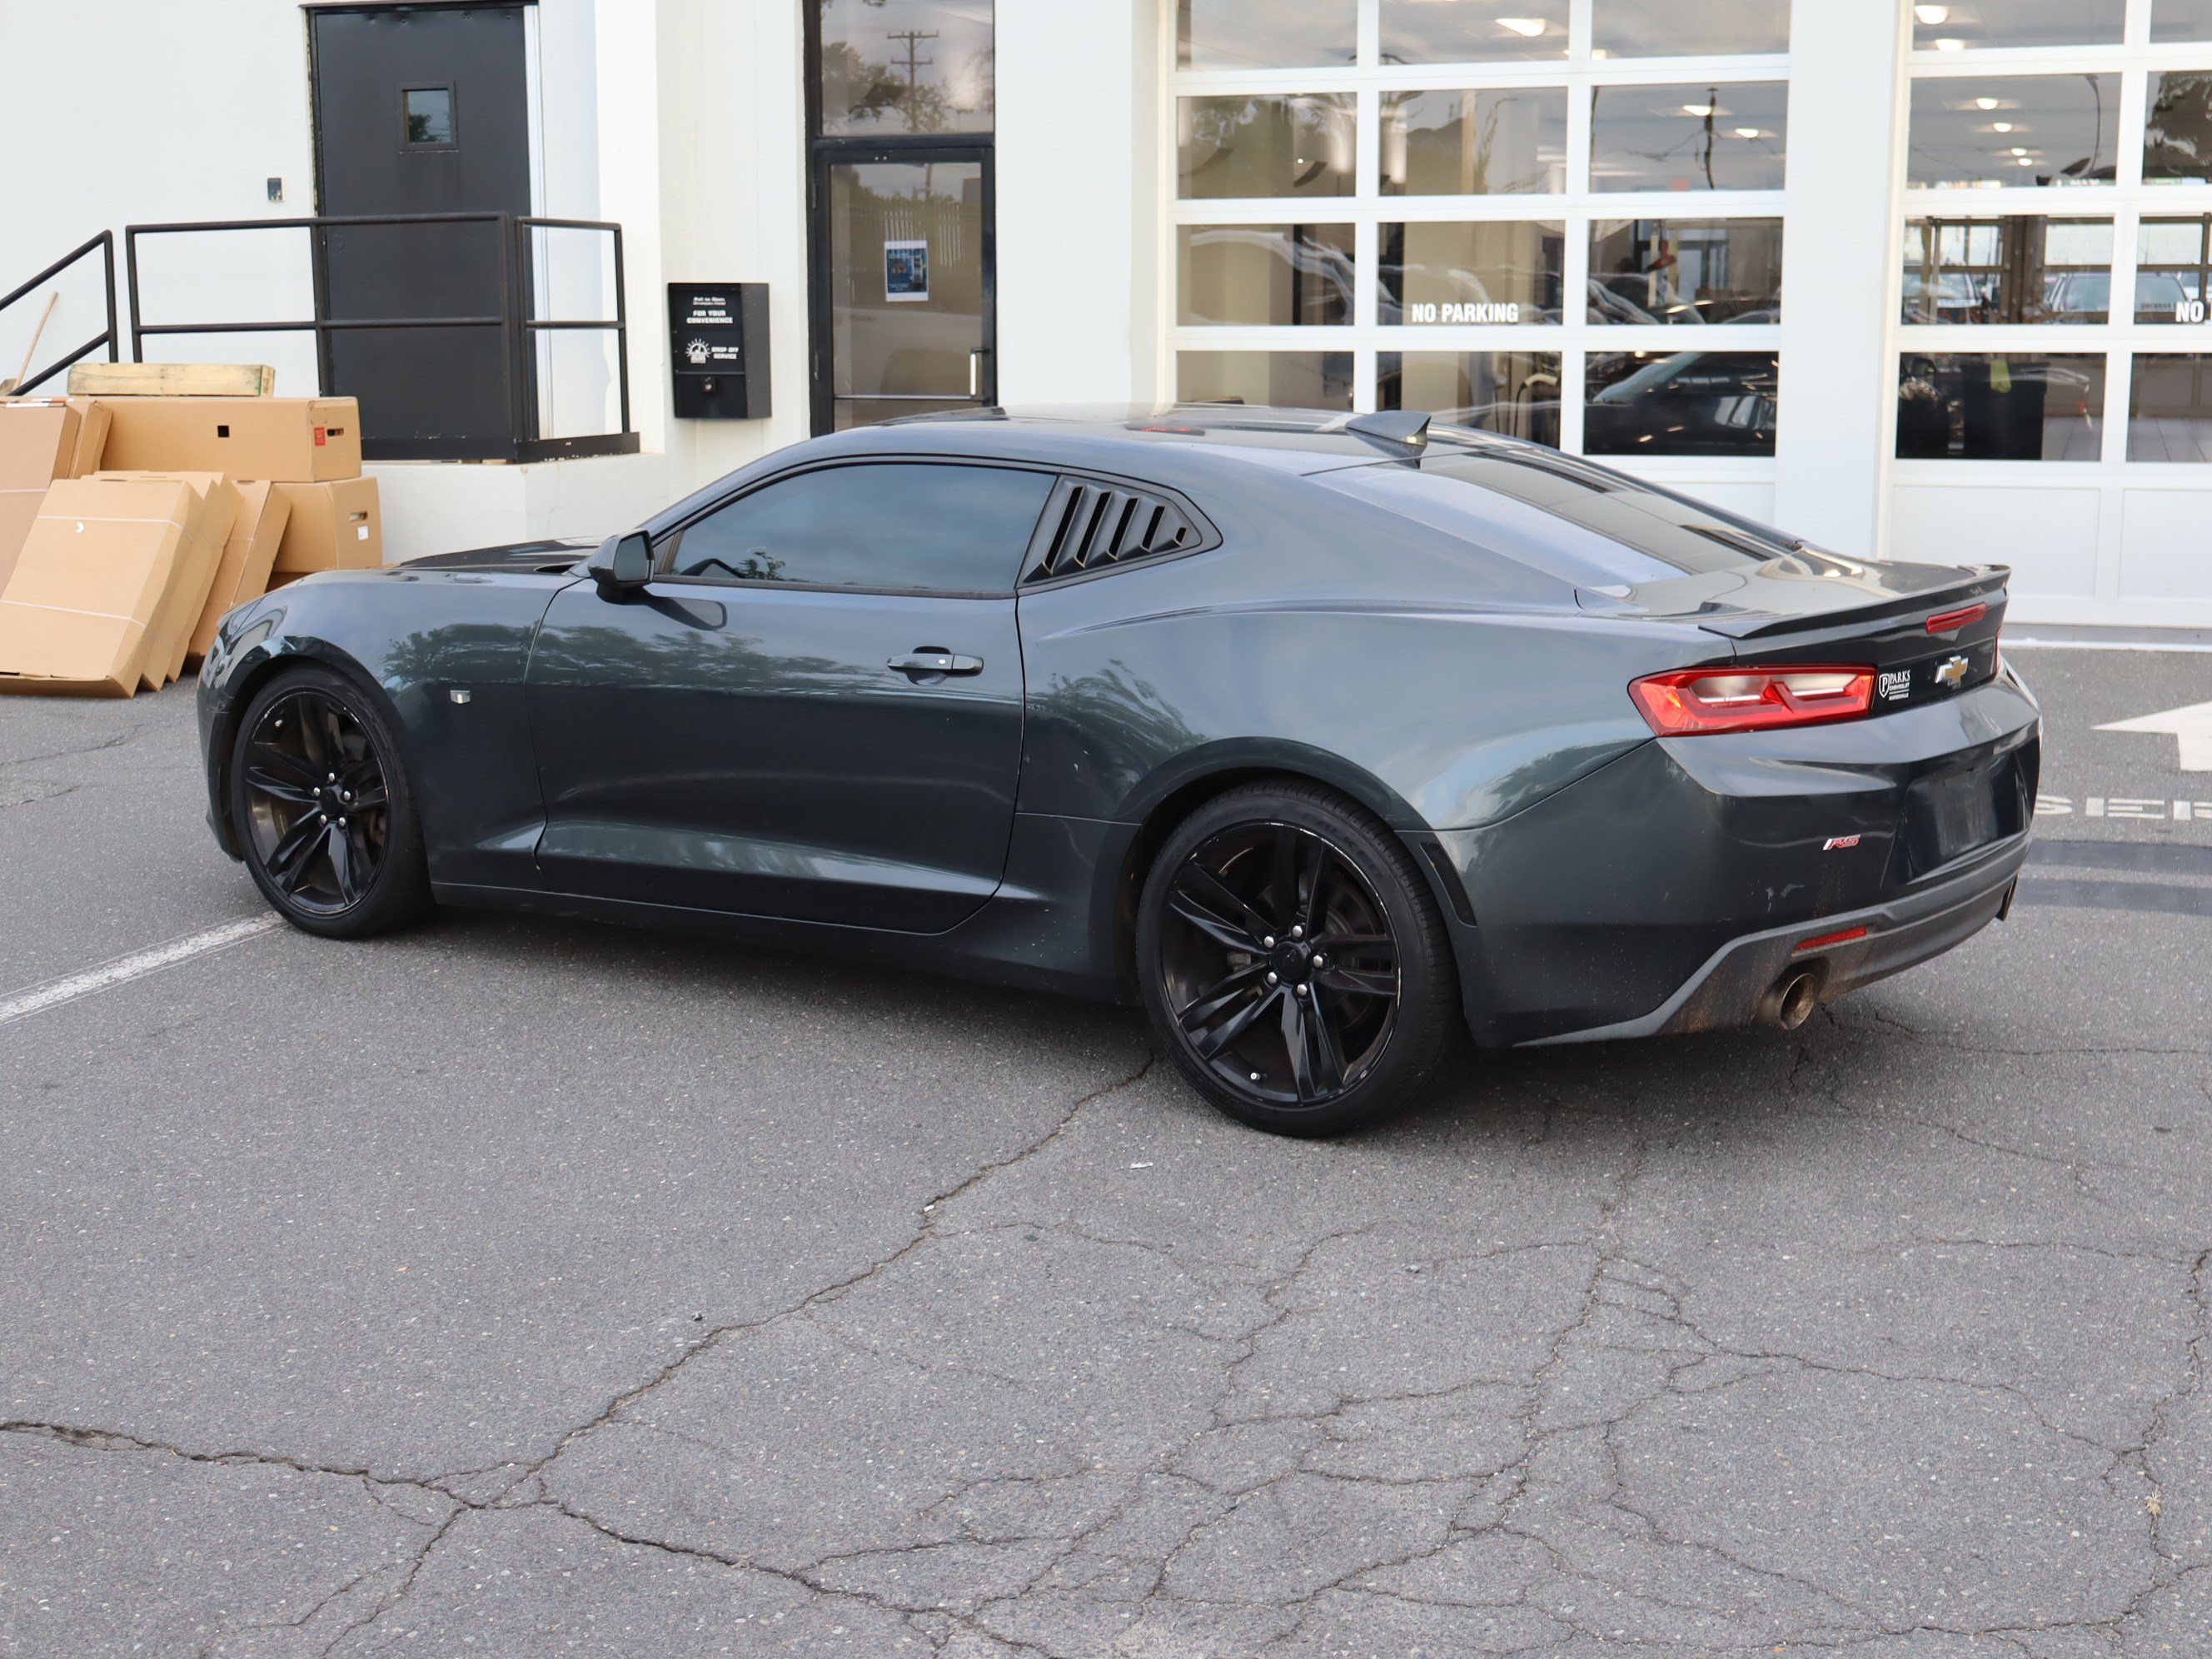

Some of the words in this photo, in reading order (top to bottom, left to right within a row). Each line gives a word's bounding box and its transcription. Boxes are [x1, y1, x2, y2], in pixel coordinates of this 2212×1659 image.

[1412, 303, 1437, 322] NO
[1441, 303, 1519, 323] PARKING
[2175, 301, 2205, 322] NO
[1890, 670, 1911, 684] PARKS
[1822, 834, 1861, 851] RS
